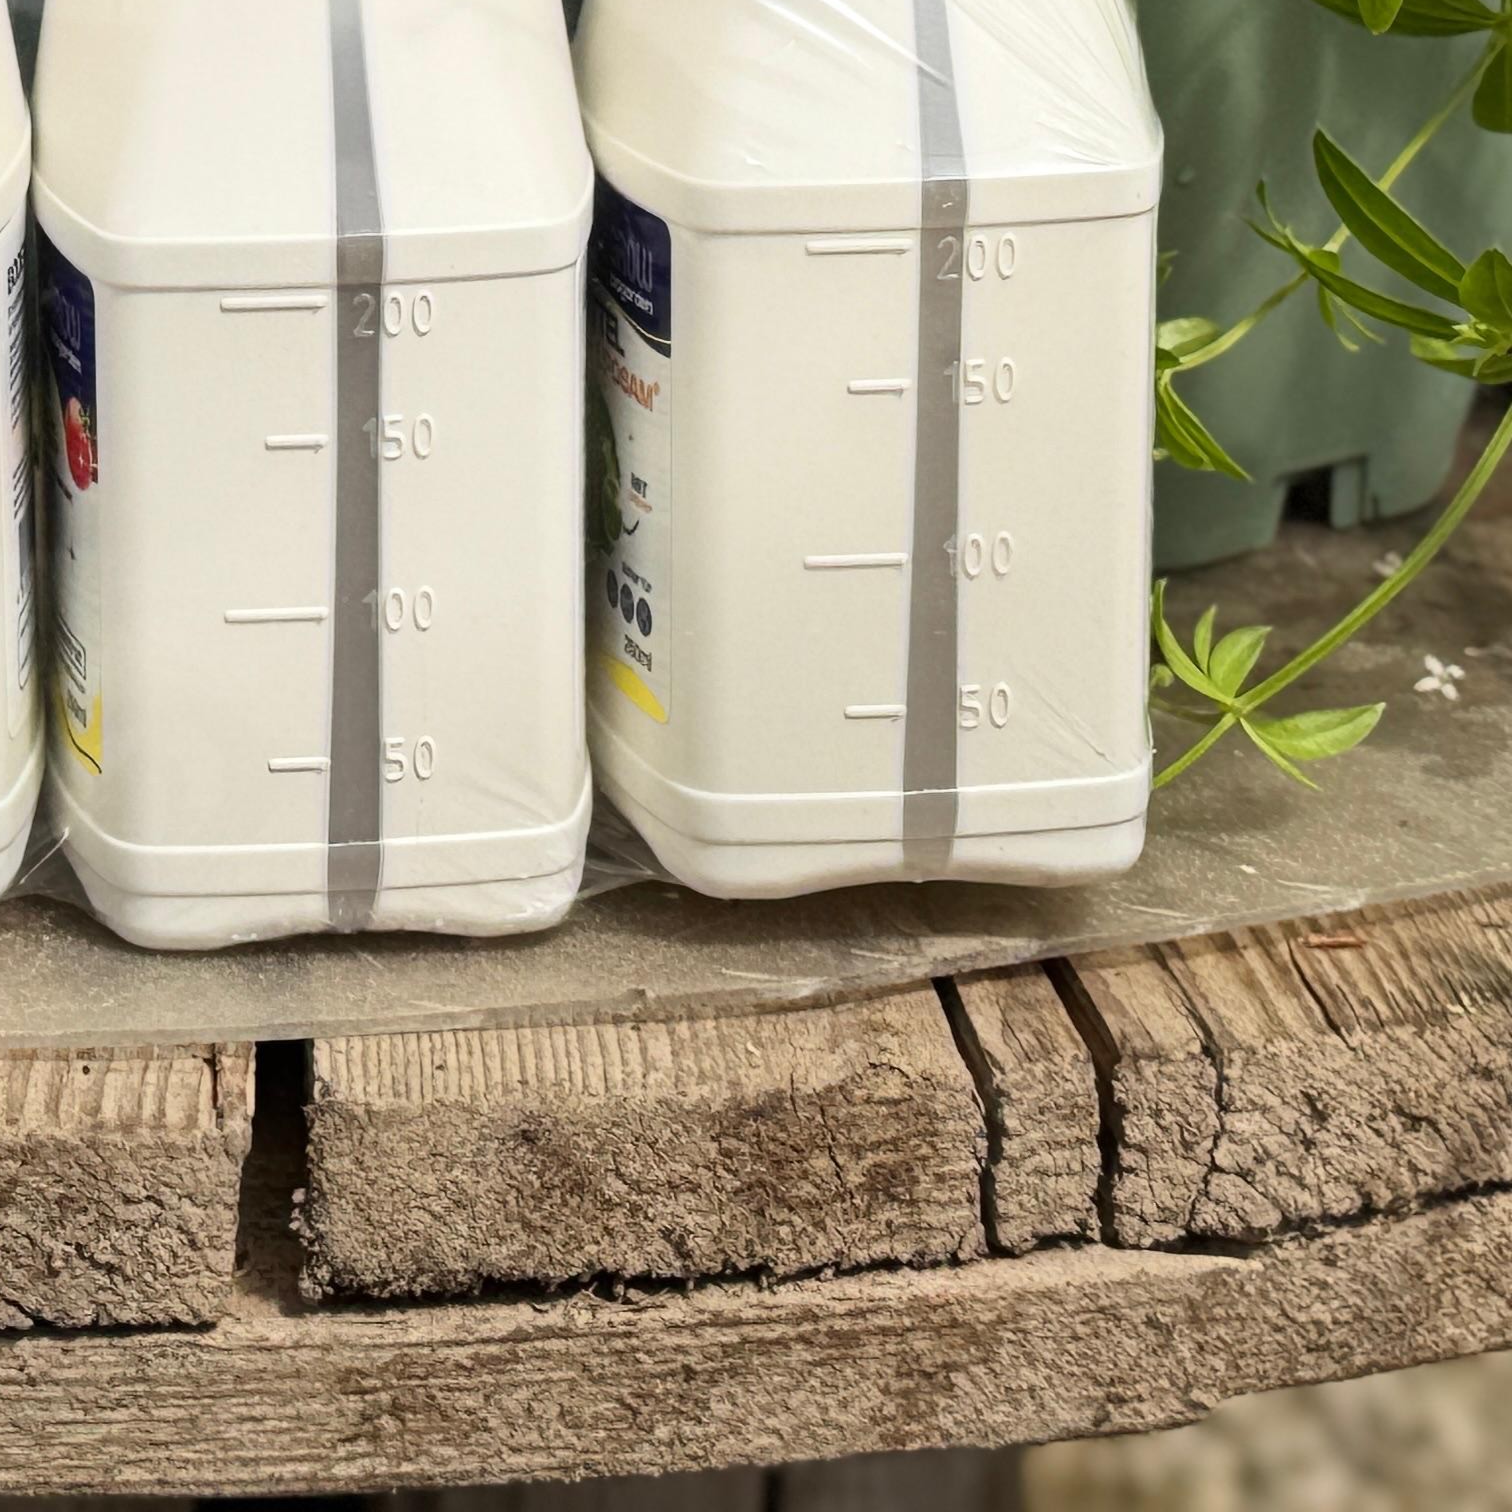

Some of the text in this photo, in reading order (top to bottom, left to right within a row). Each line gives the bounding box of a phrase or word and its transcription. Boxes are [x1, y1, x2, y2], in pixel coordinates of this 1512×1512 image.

[936, 232, 1017, 280] 200
[352, 289, 435, 339] 200
[958, 680, 1015, 729] 50
[383, 735, 437, 782] 50
